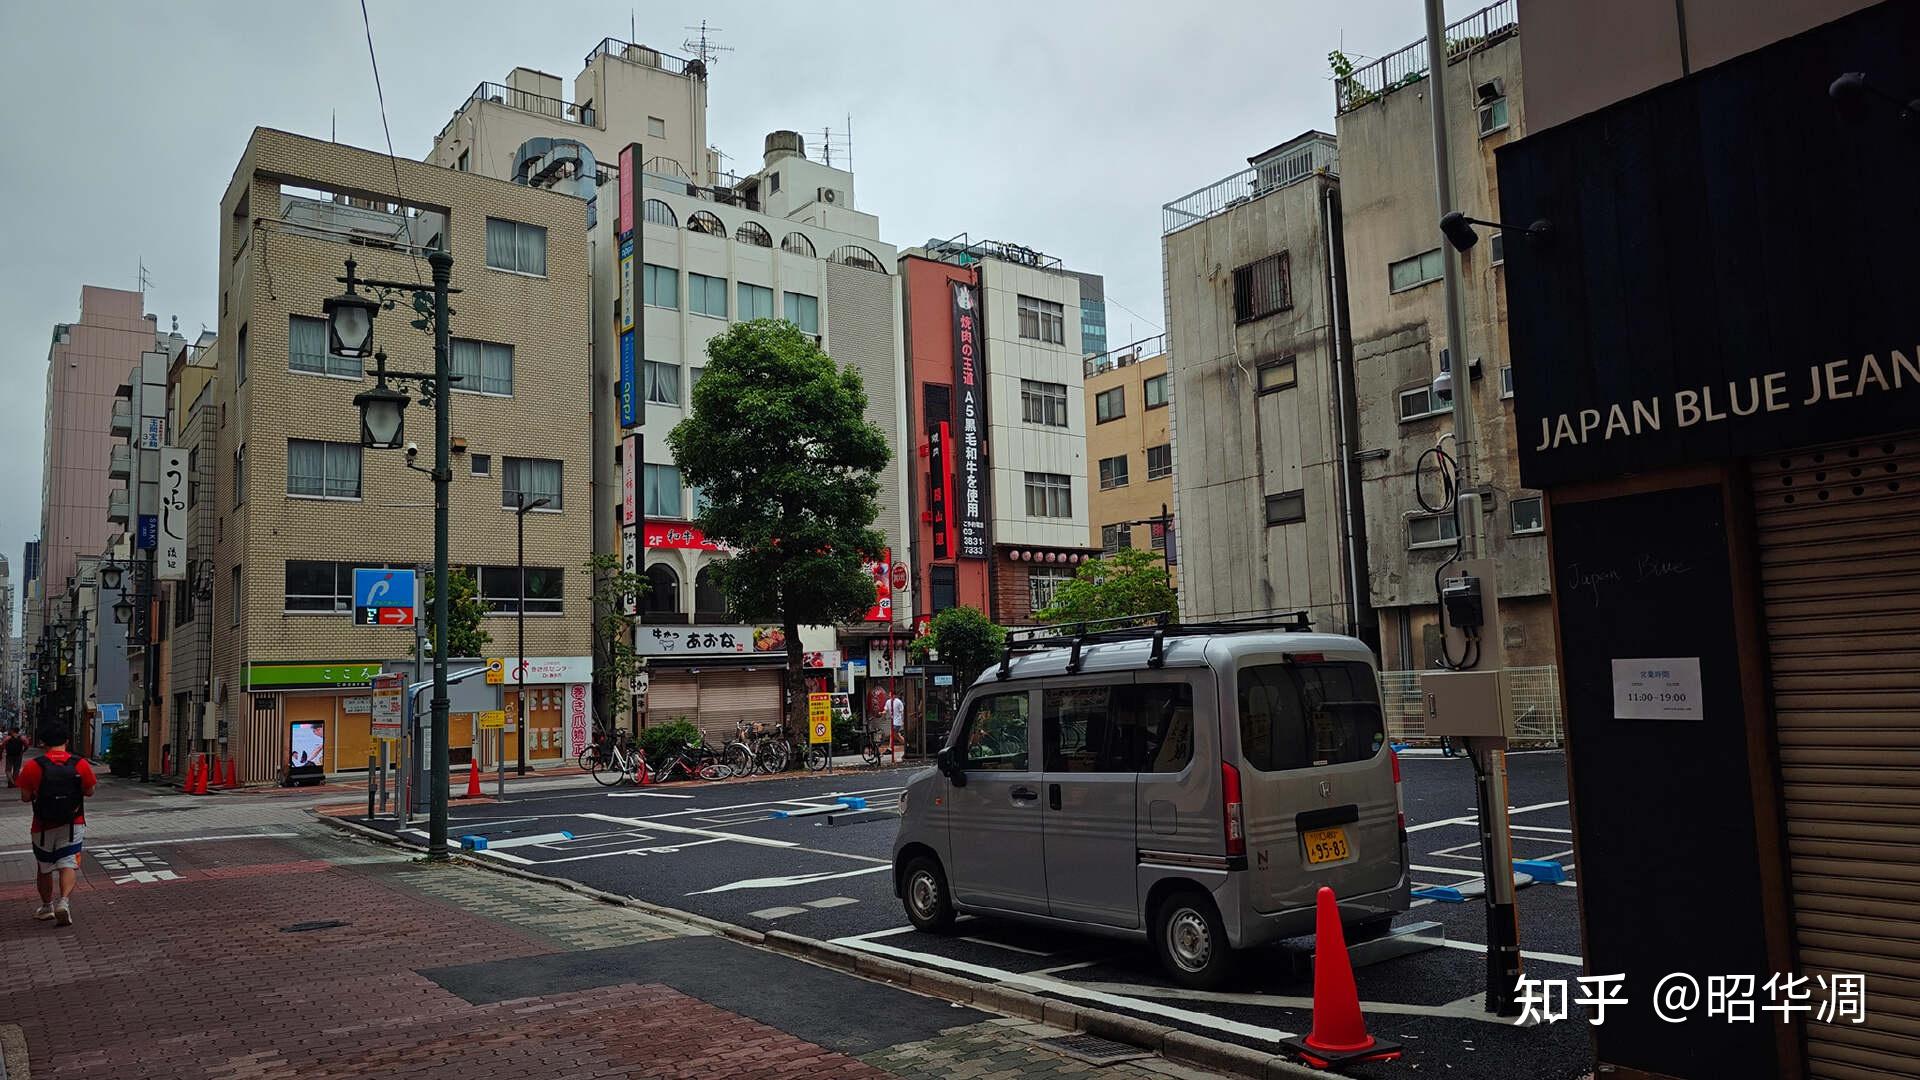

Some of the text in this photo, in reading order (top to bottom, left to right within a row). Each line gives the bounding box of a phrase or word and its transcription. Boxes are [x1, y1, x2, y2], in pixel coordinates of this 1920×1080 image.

[960, 315, 979, 518] 焼肉の王道 A5黒毛和牛を使用
[1536, 396, 1661, 451] JAPAN
[1675, 371, 1790, 428] BLUE
[649, 528, 696, 546] 2F 和牛
[963, 546, 984, 555] 7333
[686, 632, 736, 649] あおな
[1315, 839, 1346, 860] 95-83
